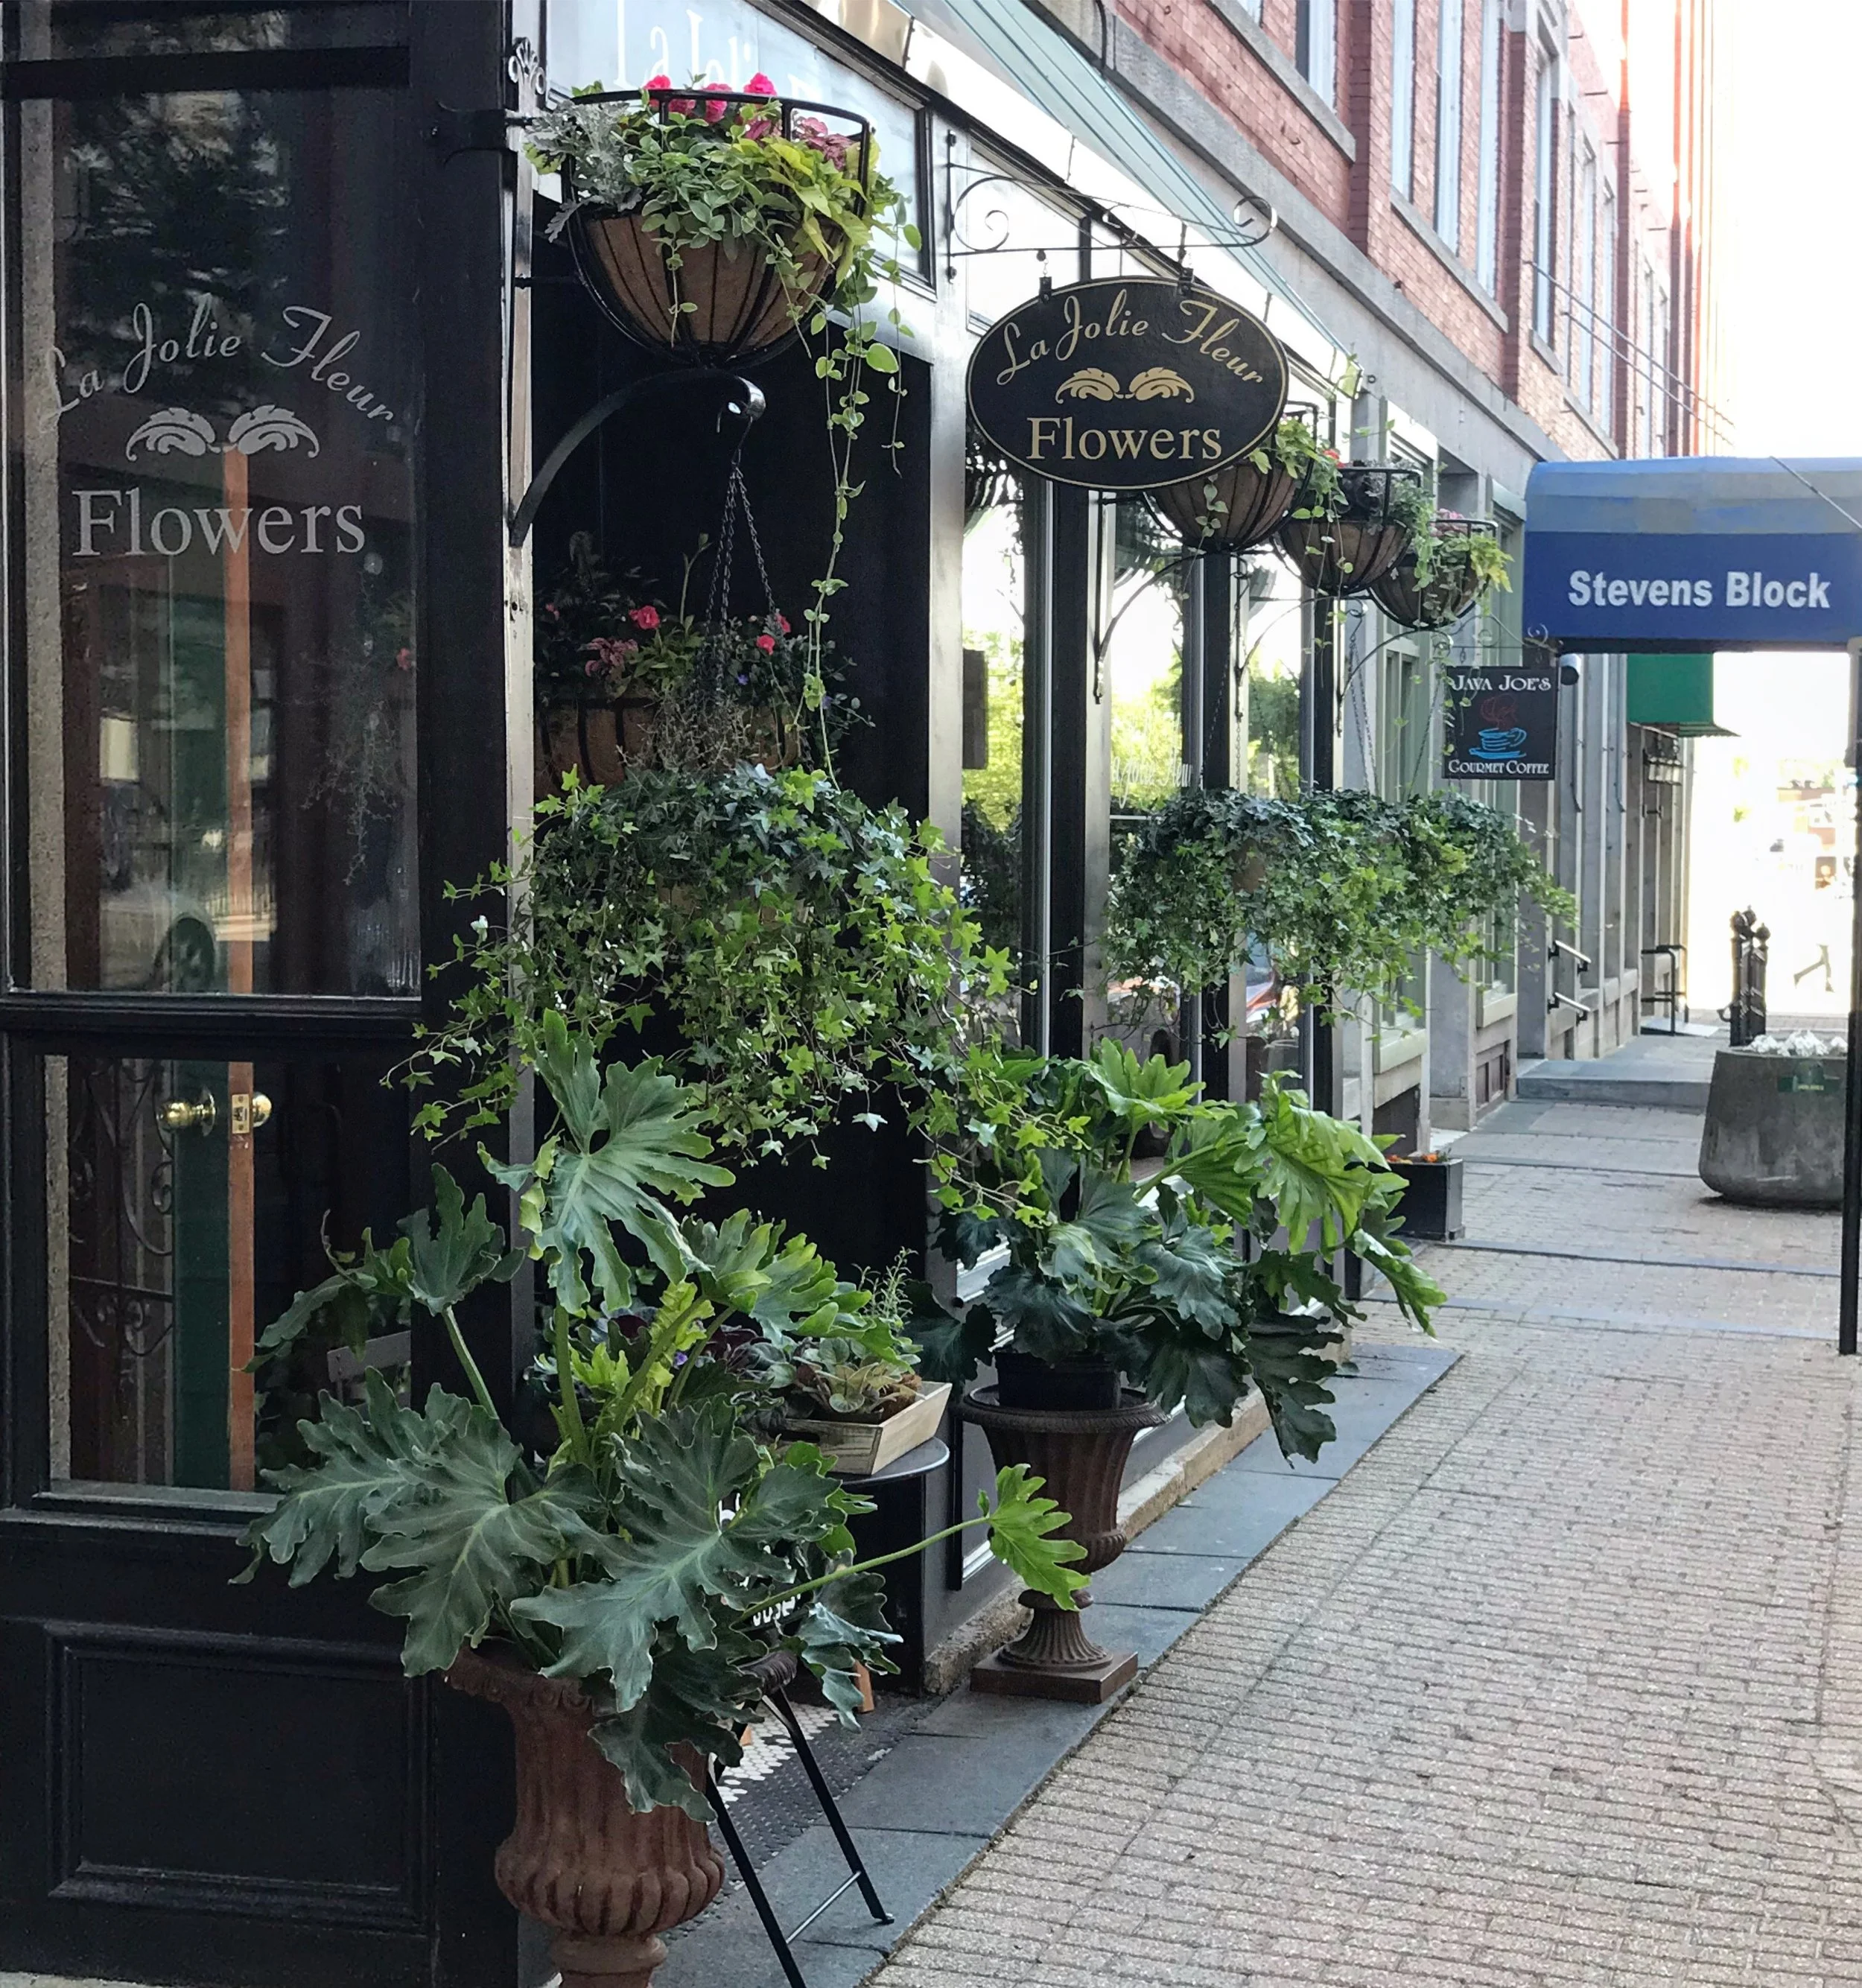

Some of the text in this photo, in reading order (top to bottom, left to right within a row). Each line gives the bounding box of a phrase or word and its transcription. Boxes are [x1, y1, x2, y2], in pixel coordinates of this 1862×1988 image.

[39, 292, 394, 426] La Jolie Fleur
[997, 288, 1263, 386] La Jolie Fleur
[1026, 416, 1222, 460] Flowers
[72, 486, 365, 556] Flowers
[1568, 570, 1831, 609] Stevens Block
[1452, 675, 1493, 691] JAVA
[1448, 759, 1550, 775] GOURMET COFFEE
